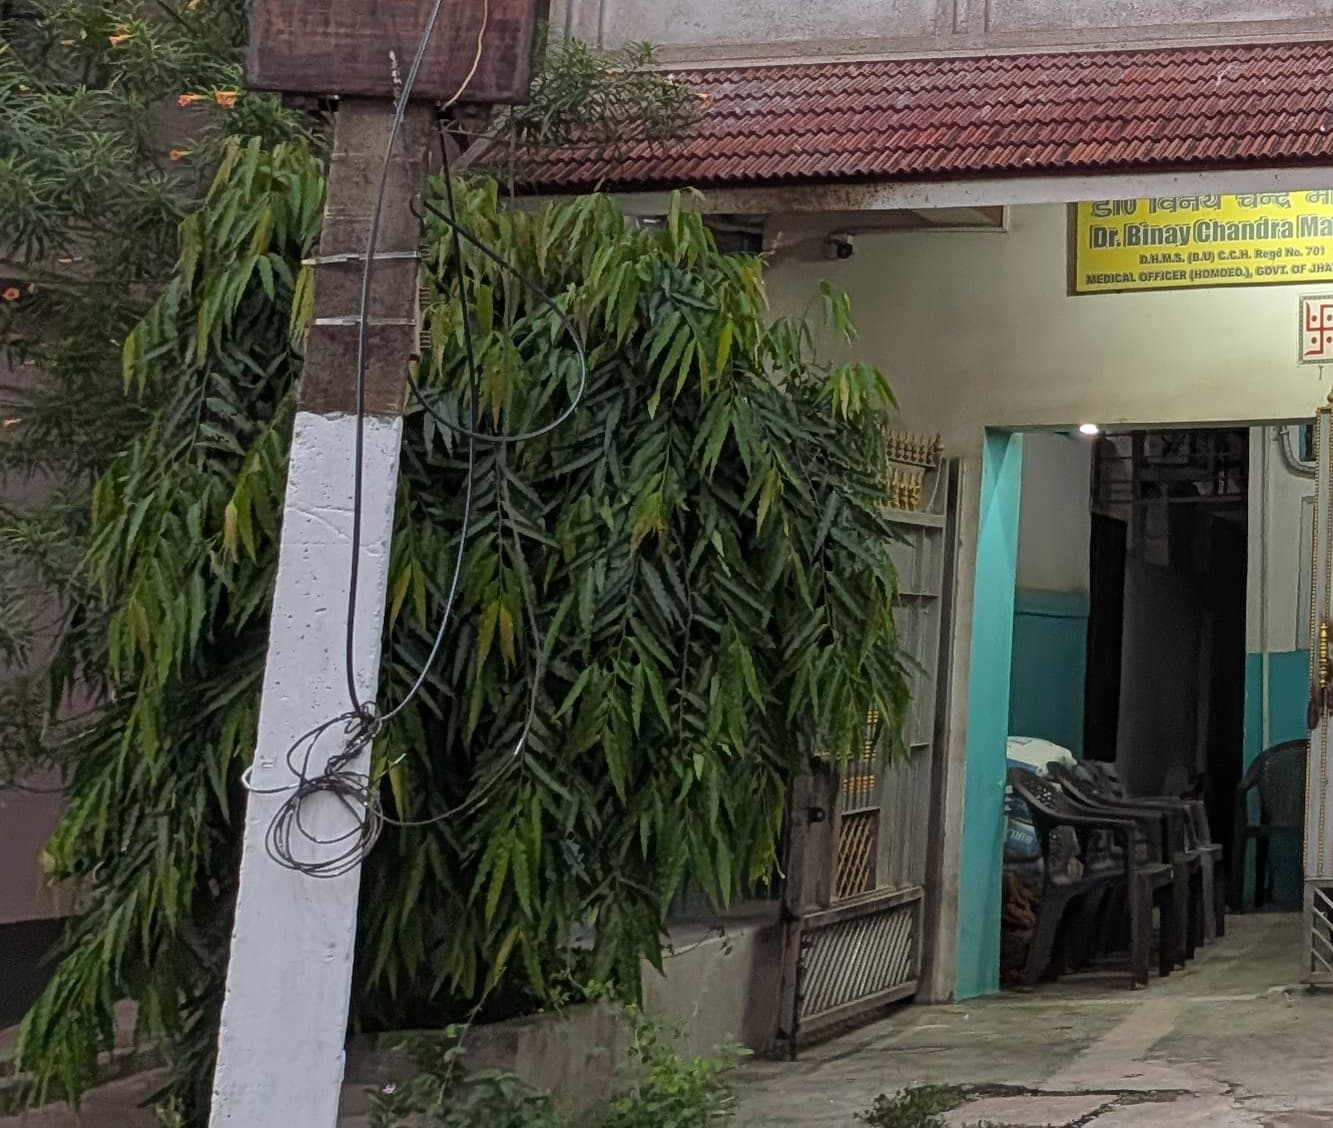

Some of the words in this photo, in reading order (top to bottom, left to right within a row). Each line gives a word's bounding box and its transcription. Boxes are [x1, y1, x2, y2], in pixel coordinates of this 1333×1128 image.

[1090, 225, 1121, 248] Dr.
[1124, 223, 1191, 247] Binay
[1193, 217, 1293, 243] Chandra
[1139, 253, 1185, 264] D.H.M.S.
[1187, 251, 1215, 264] (B.U)
[1254, 248, 1282, 260] Regd
[1285, 247, 1303, 257] No.
[1086, 273, 1136, 284] MEDICAL
[1138, 270, 1187, 282] OFFICER
[1255, 265, 1288, 275] GOVT.
[1290, 264, 1306, 273] OF
